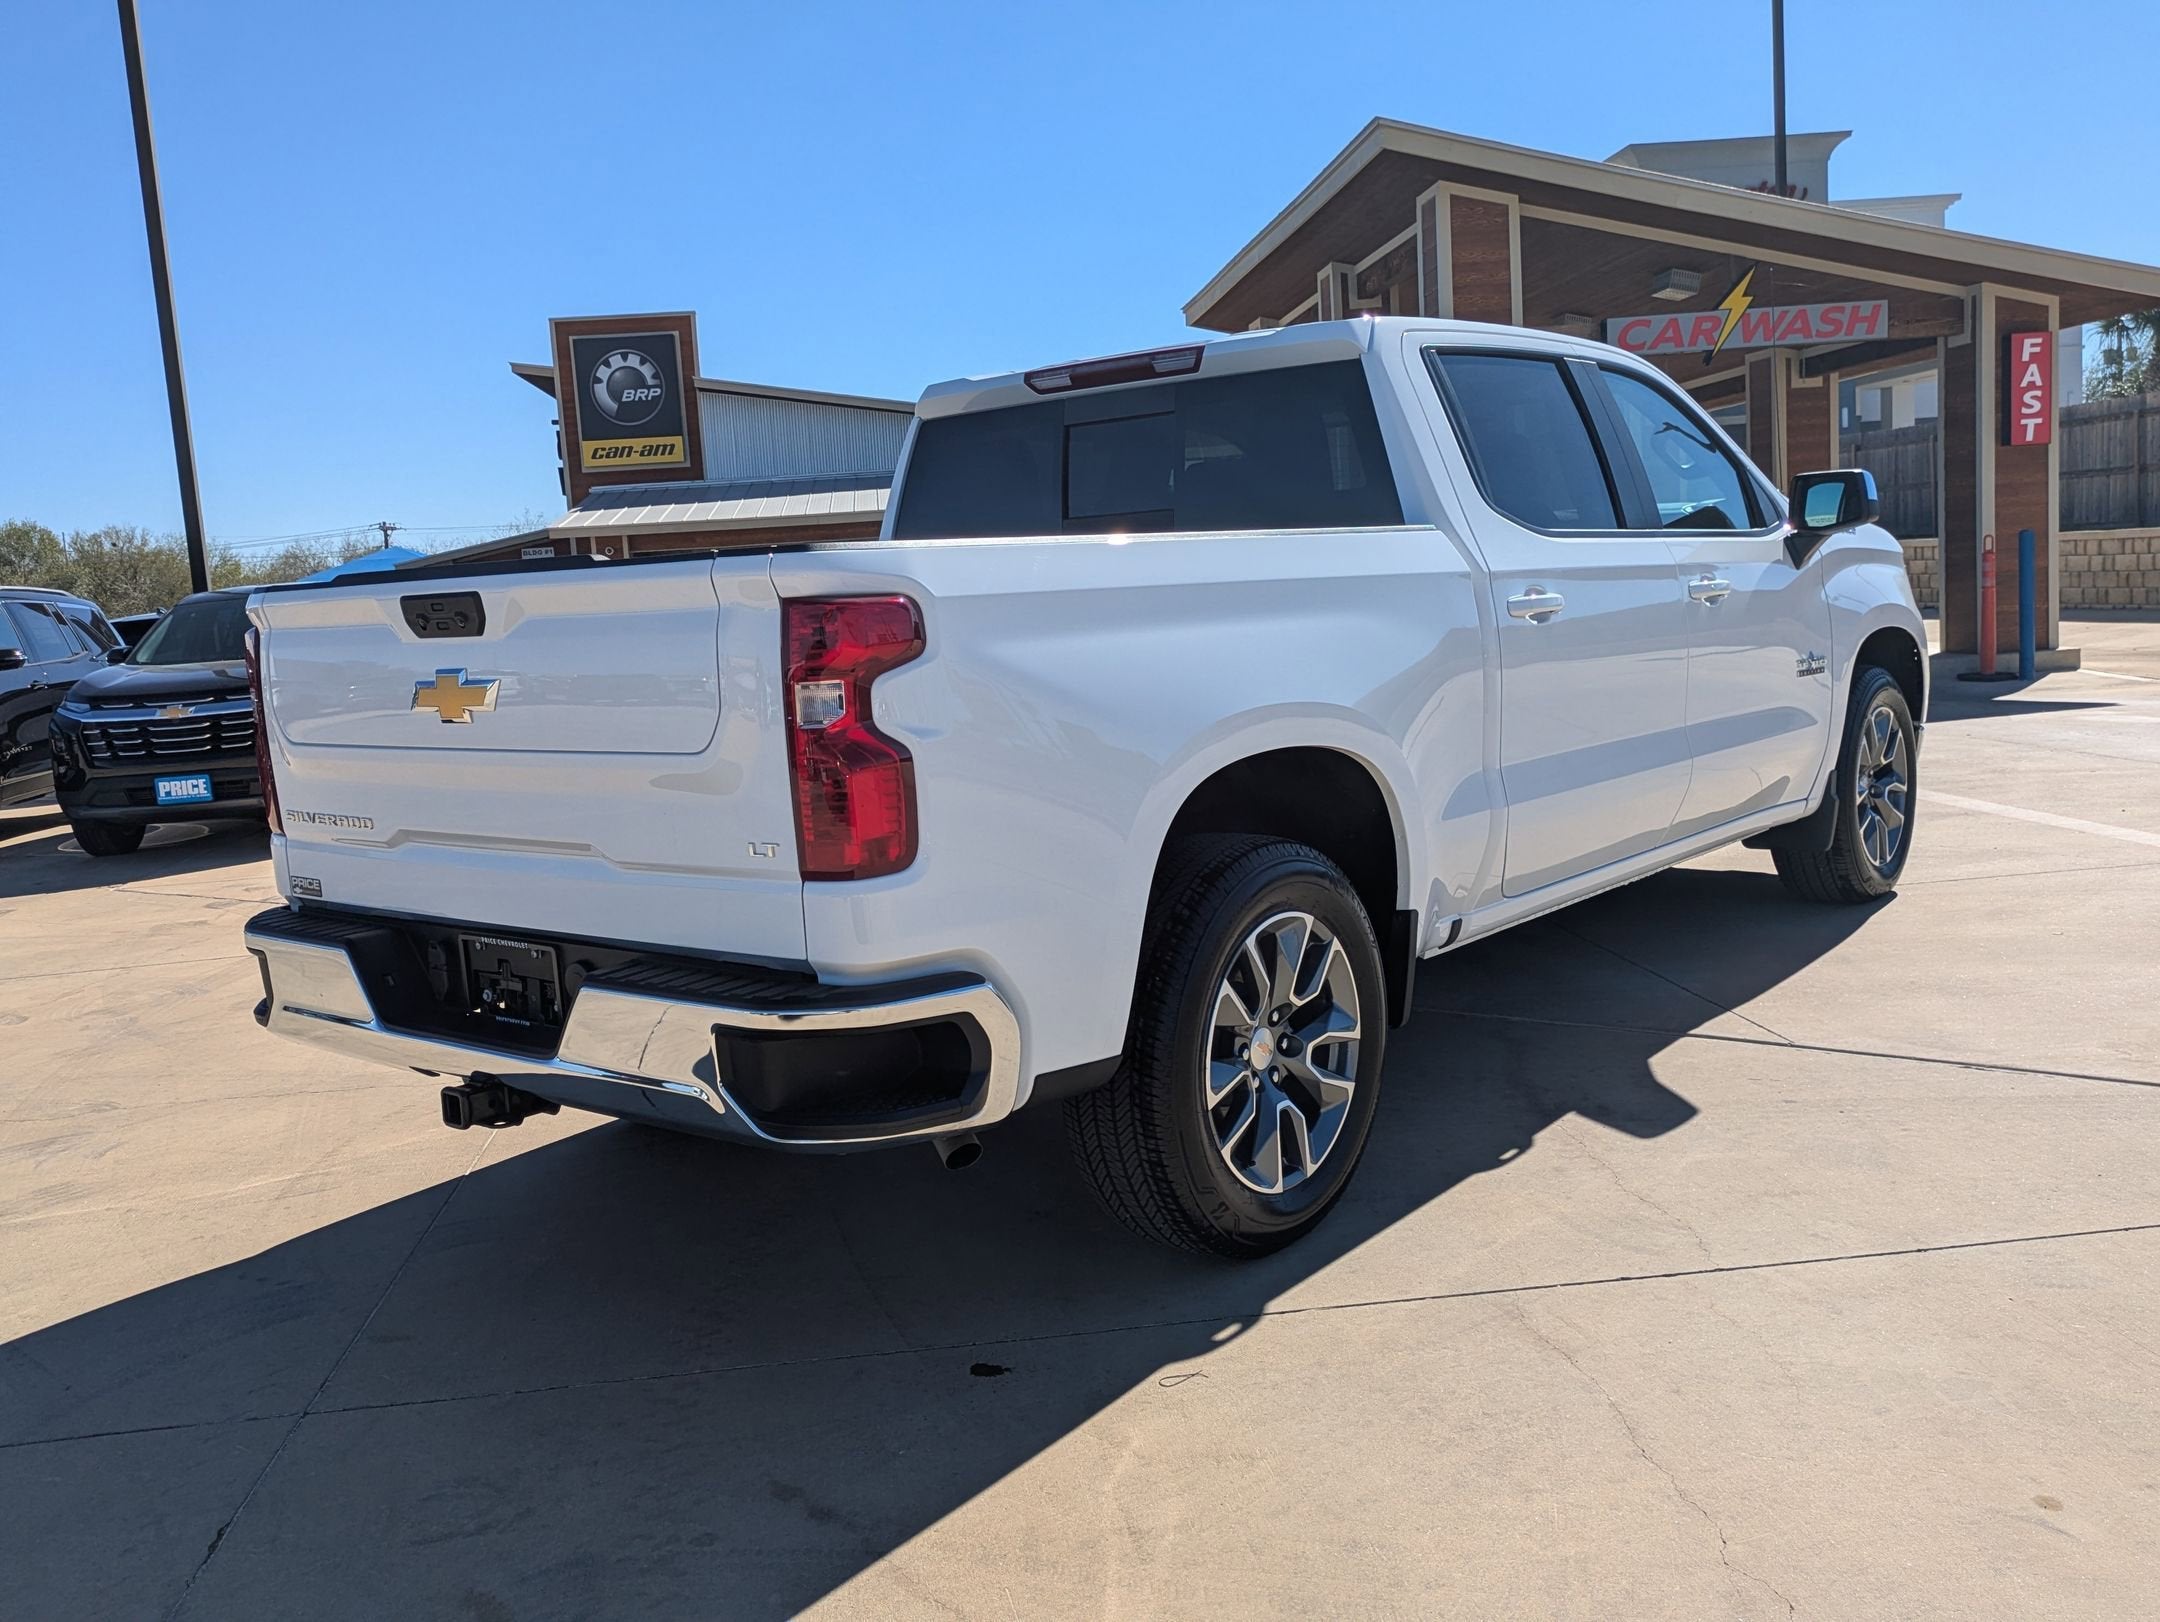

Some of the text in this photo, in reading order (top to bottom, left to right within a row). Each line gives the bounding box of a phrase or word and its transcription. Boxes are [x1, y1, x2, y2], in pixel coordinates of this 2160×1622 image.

[1617, 304, 1882, 350] CAR WASH
[621, 388, 662, 402] BRP
[2020, 337, 2043, 442] FAST
[591, 443, 675, 460] can-am
[158, 779, 208, 797] PRICE
[286, 809, 375, 830] SILVERADO
[748, 841, 780, 858] LT
[292, 876, 321, 890] PRICE
[481, 936, 528, 949] PRICE CHEVROLET
